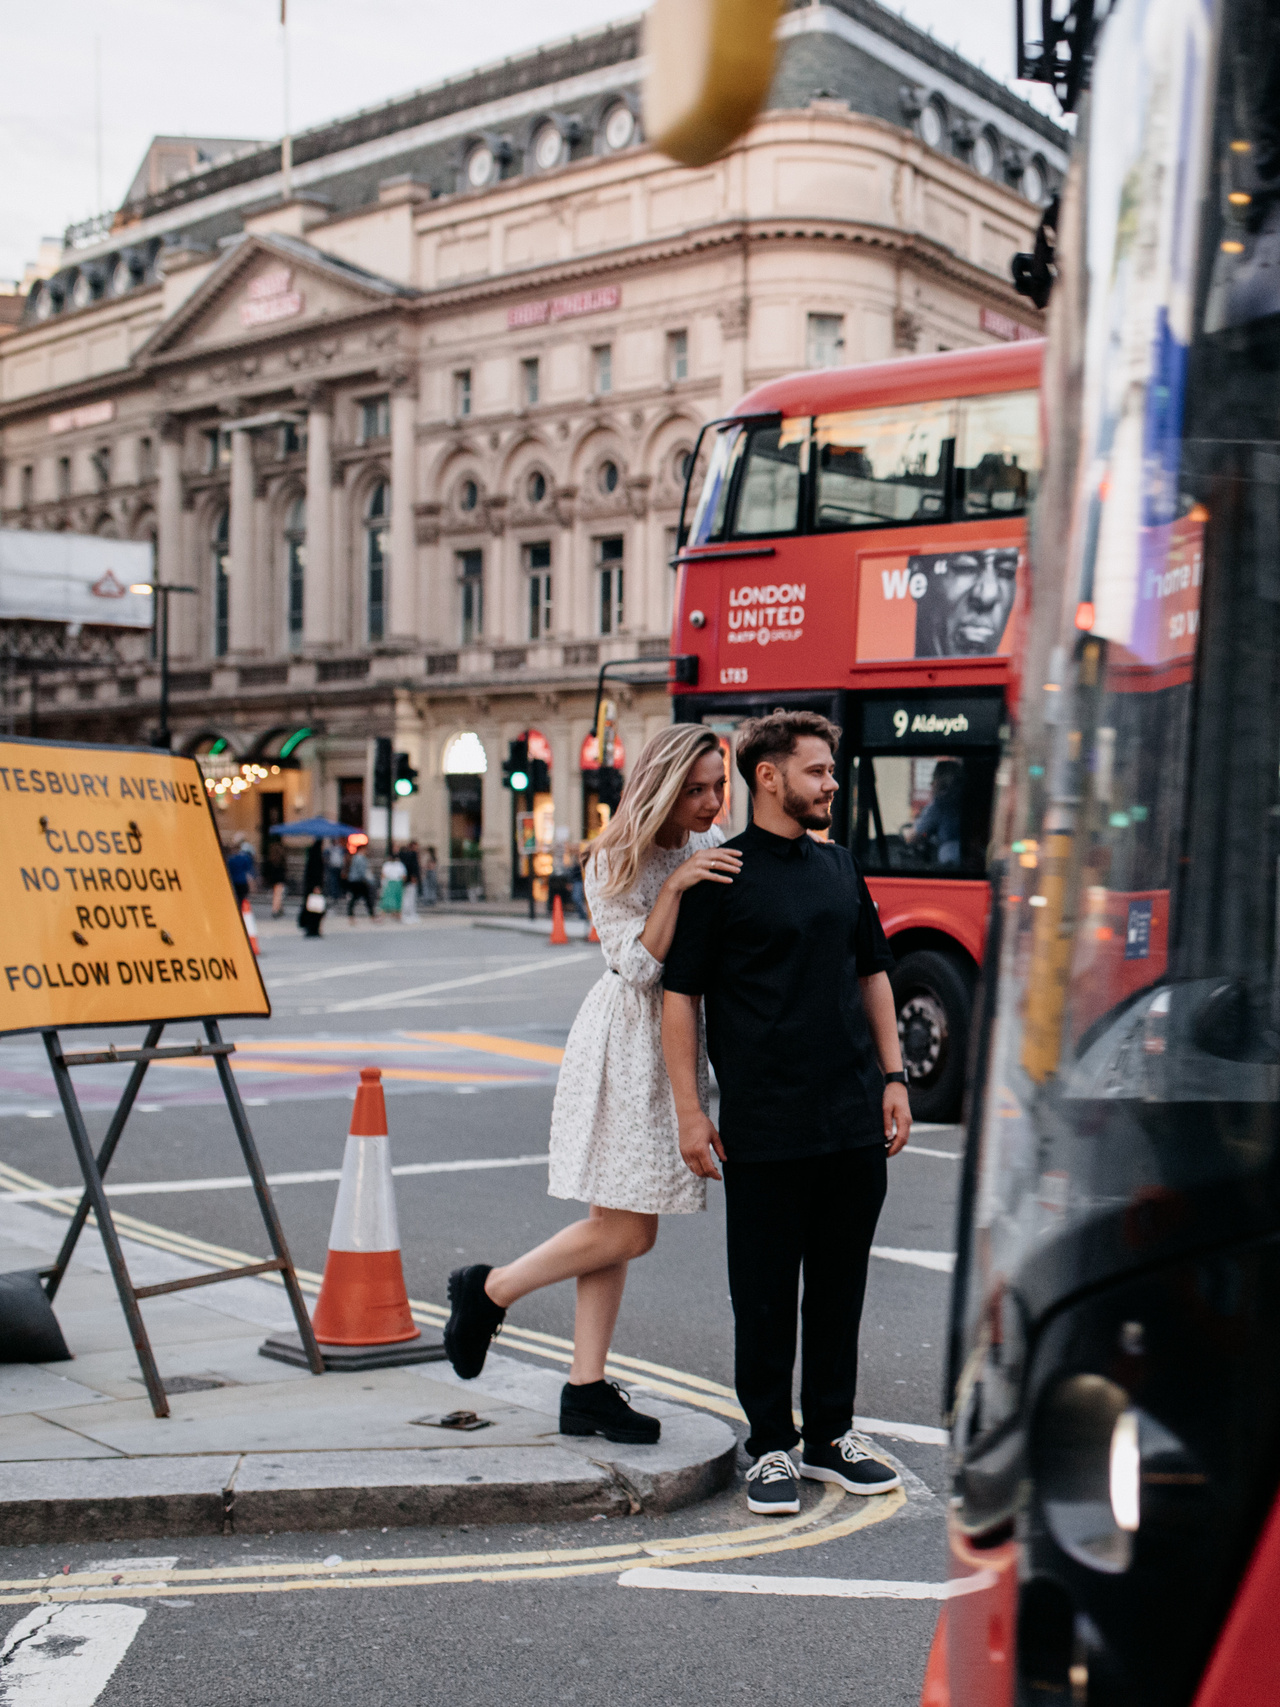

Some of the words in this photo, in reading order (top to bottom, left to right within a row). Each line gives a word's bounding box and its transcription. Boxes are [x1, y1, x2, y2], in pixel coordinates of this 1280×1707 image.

[729, 583, 806, 607] LONDON
[881, 568, 928, 600] We
[728, 606, 805, 629] UNITED
[893, 709, 909, 738] 9
[911, 713, 969, 736] Aldwych
[0, 766, 109, 798] TESBURY
[120, 776, 202, 806] AVENUE
[46, 829, 142, 854] CLOSED
[20, 867, 60, 892] NO
[65, 867, 182, 892] THROUGH
[76, 905, 157, 930] ROUTE
[5, 961, 110, 992] FOLLOW
[117, 957, 238, 985] DIVERSION
